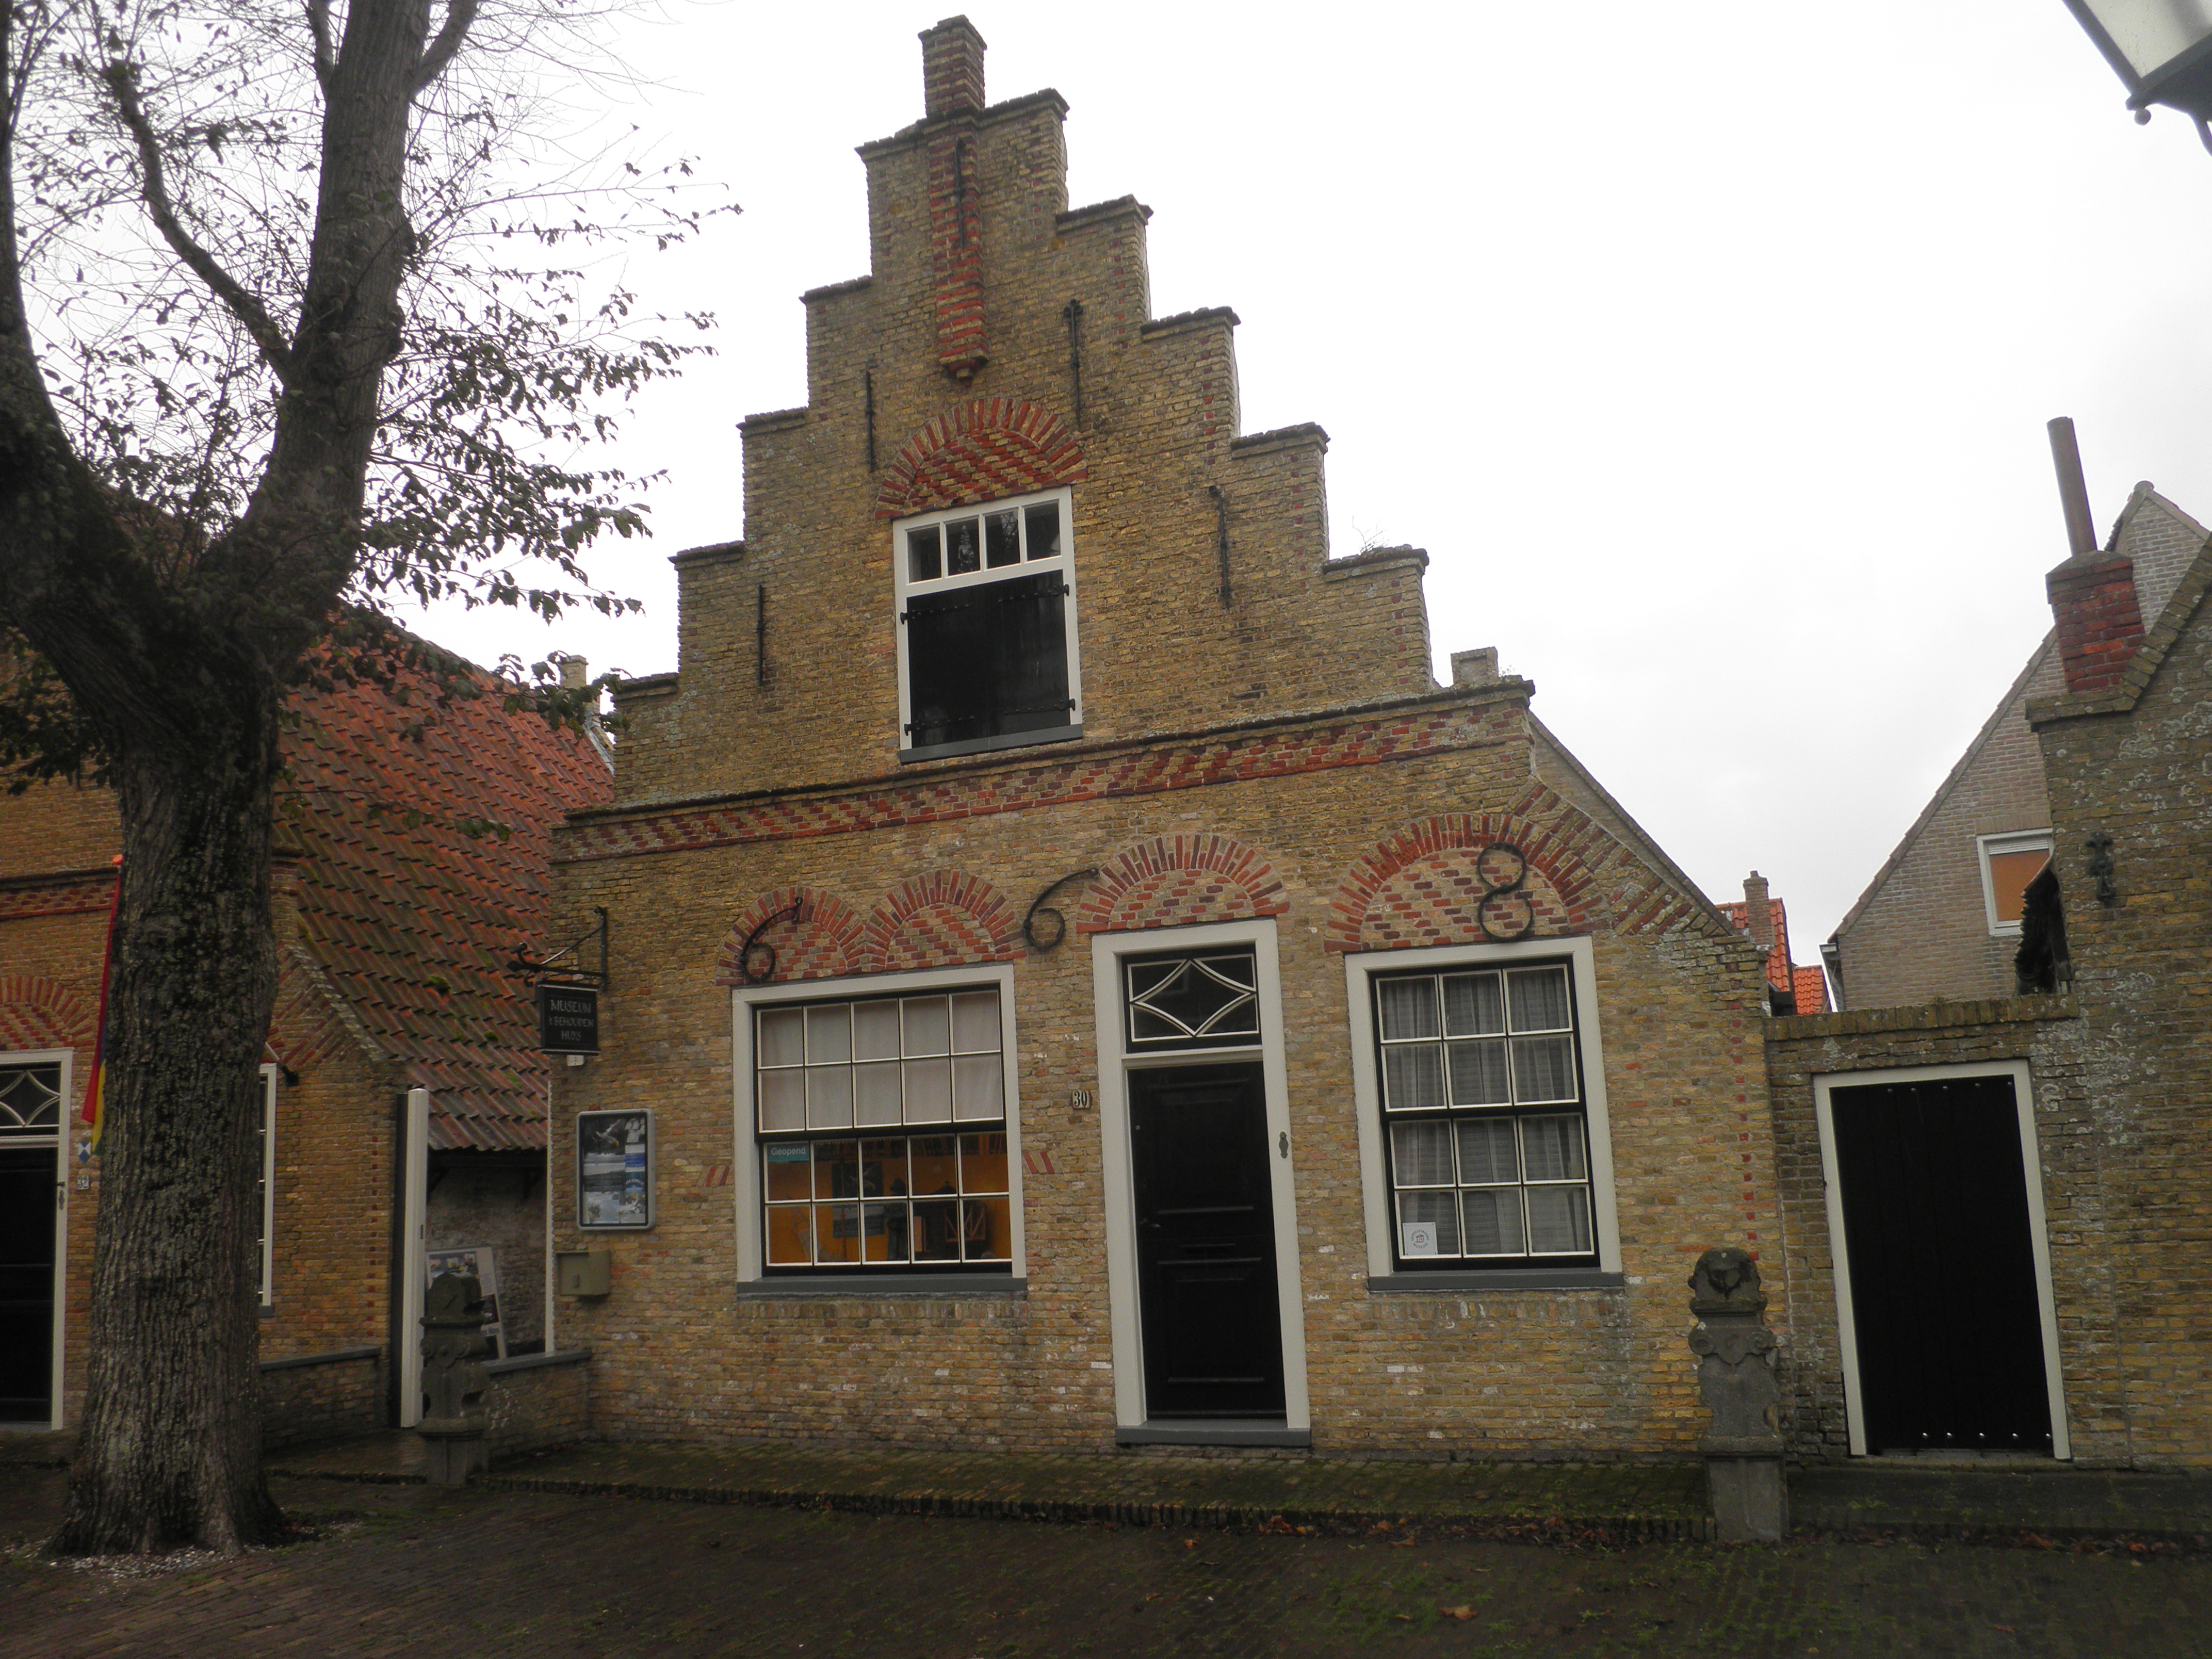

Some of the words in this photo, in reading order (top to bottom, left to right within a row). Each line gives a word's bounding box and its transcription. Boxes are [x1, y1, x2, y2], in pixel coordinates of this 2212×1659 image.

[550, 999, 591, 1014] MUSEUM
[554, 1016, 594, 1027] BEHOUDEN
[561, 1030, 581, 1042] HUYS
[1074, 1091, 1087, 1107] 30
[771, 1146, 806, 1157] Geopend
[78, 1176, 87, 1188] 32
